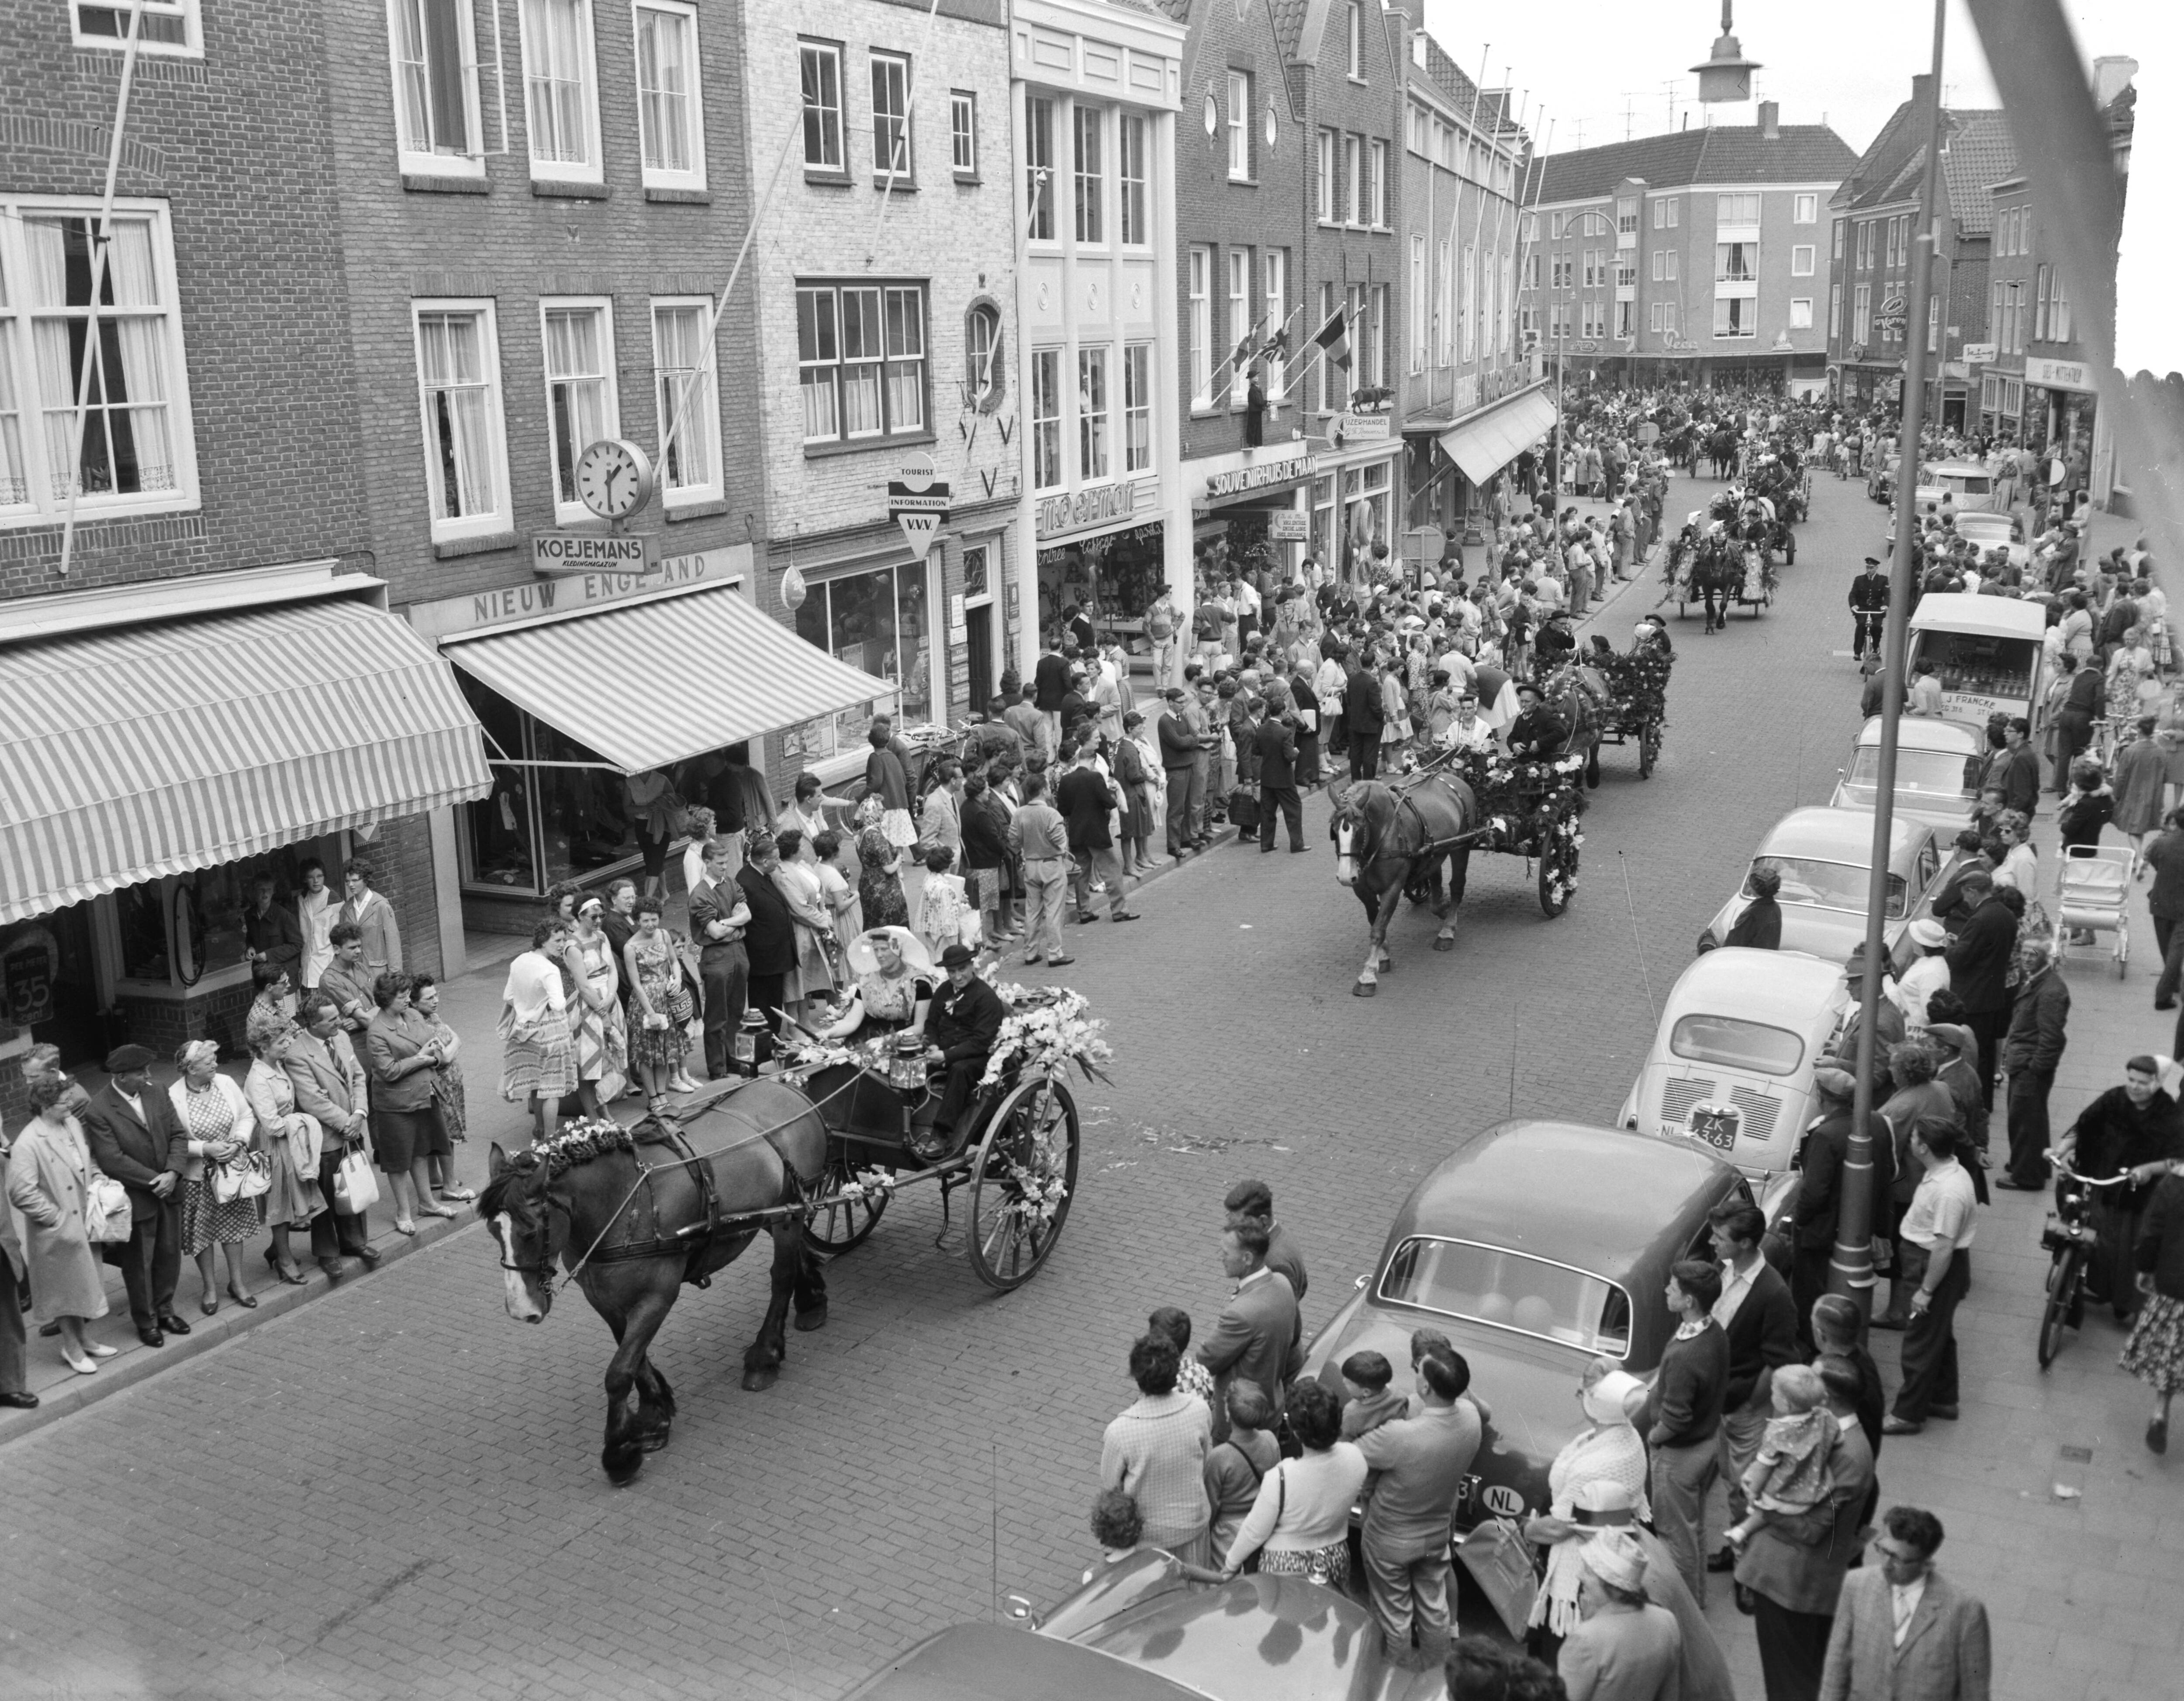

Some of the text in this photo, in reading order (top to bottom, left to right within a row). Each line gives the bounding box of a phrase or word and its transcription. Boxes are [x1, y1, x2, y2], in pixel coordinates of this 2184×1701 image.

[1967, 347, 1994, 360] king
[906, 518, 933, 531] V.V.V.
[536, 539, 642, 559] KOEJEMANS
[1037, 549, 1066, 566] Entree
[474, 555, 705, 622] NIEUW ENGEAND
[1956, 695, 1996, 710] FRANCKE
[14, 975, 49, 1012] 35
[1704, 1116, 1725, 1132] ZK
[1491, 1488, 1516, 1513] NL
